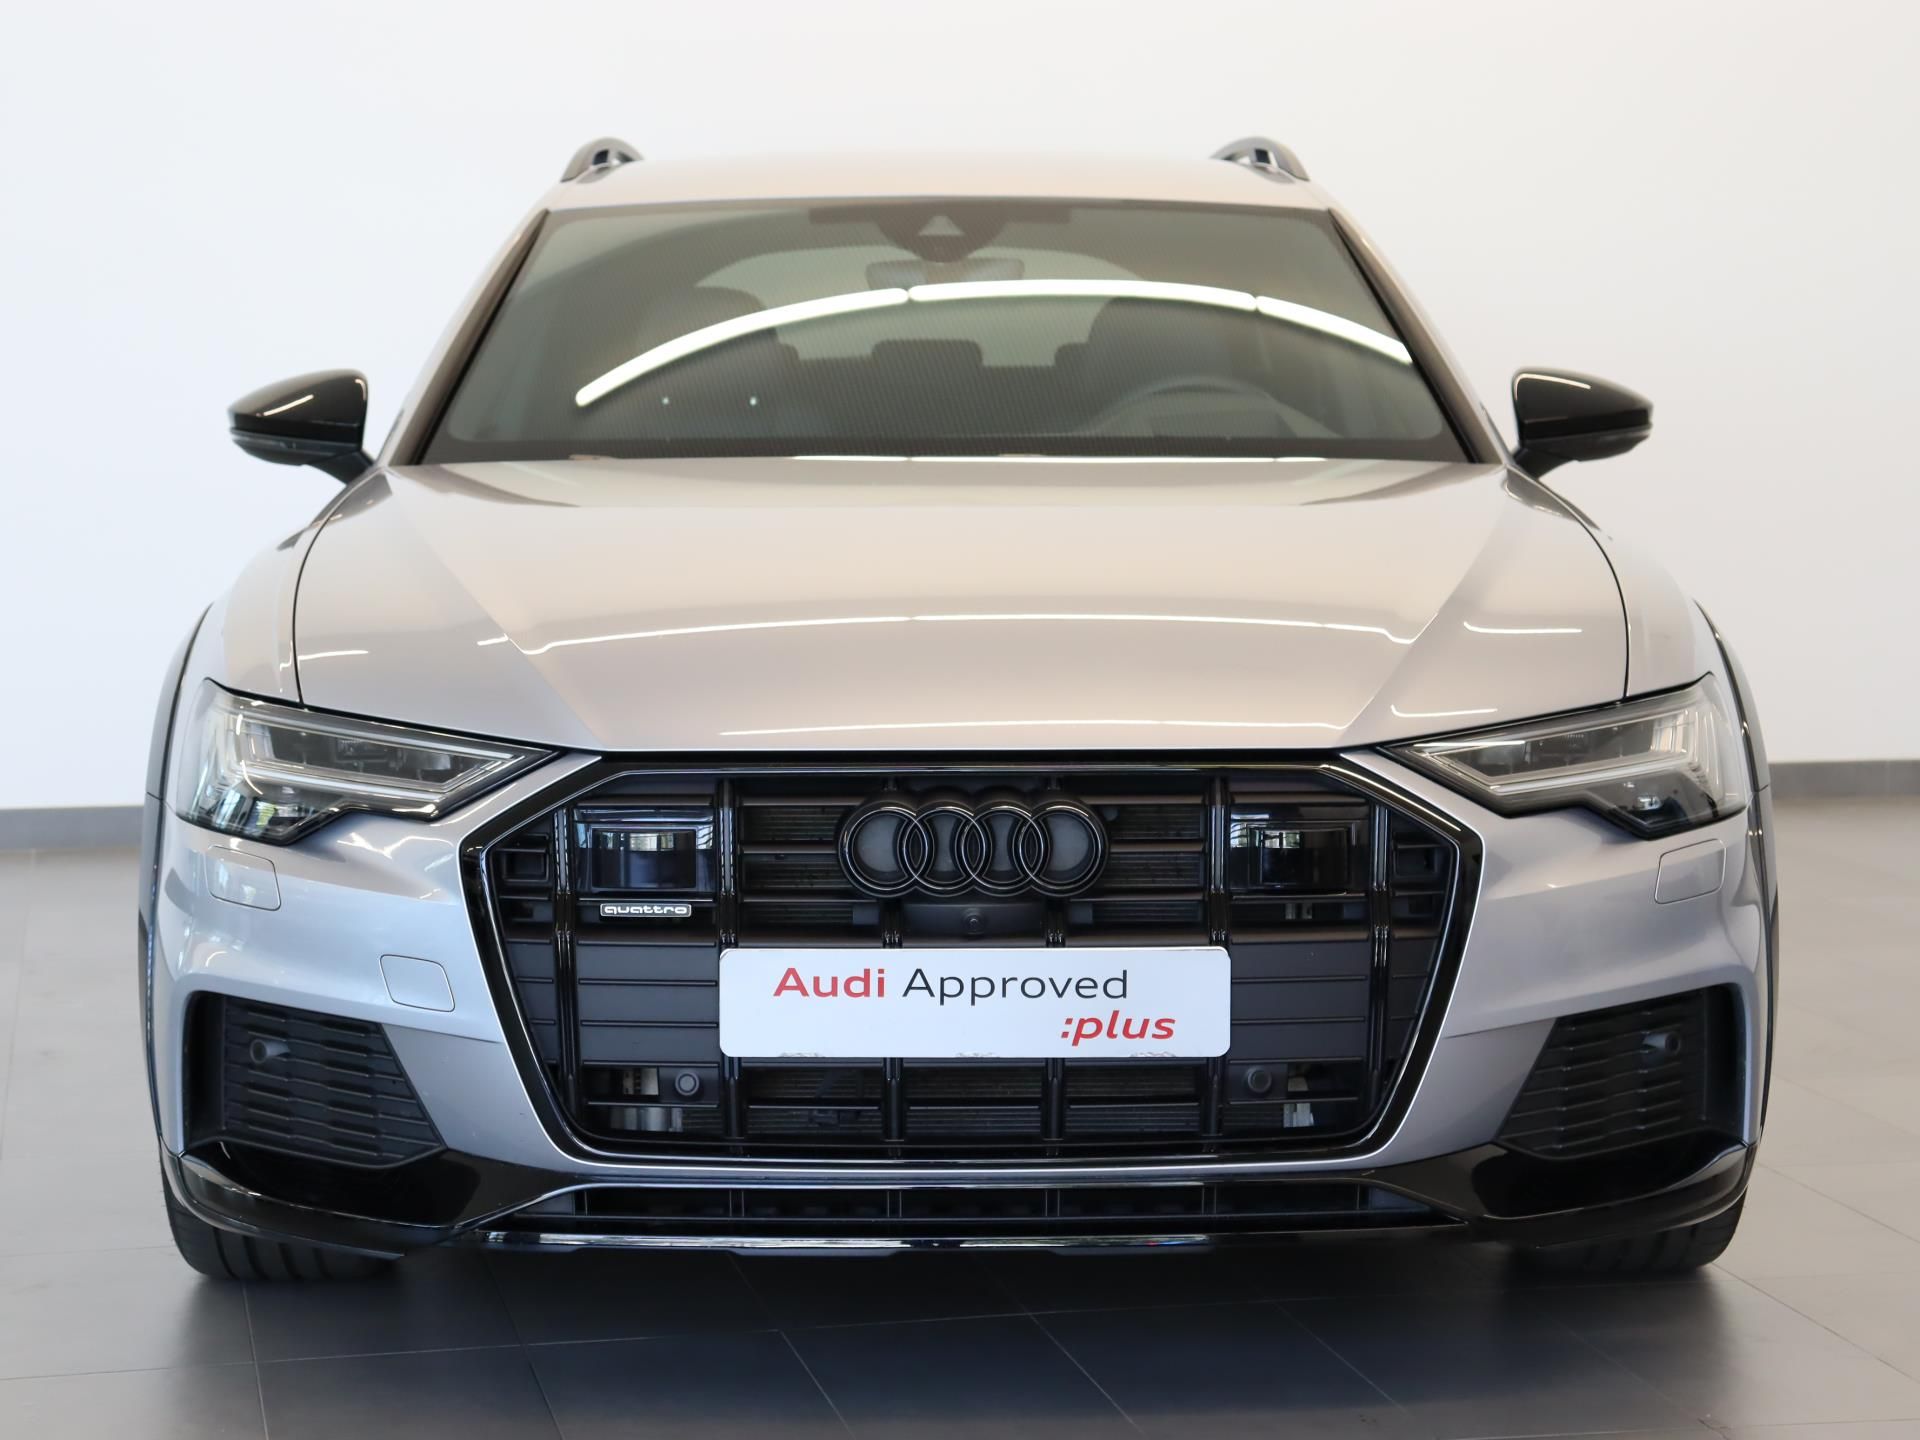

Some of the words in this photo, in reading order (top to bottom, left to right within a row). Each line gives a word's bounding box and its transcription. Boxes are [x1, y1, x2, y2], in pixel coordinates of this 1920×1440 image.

[604, 905, 688, 915] quattro
[773, 967, 886, 998] Audi
[902, 968, 1128, 1006] Approved
[1061, 1010, 1176, 1047] :plus
